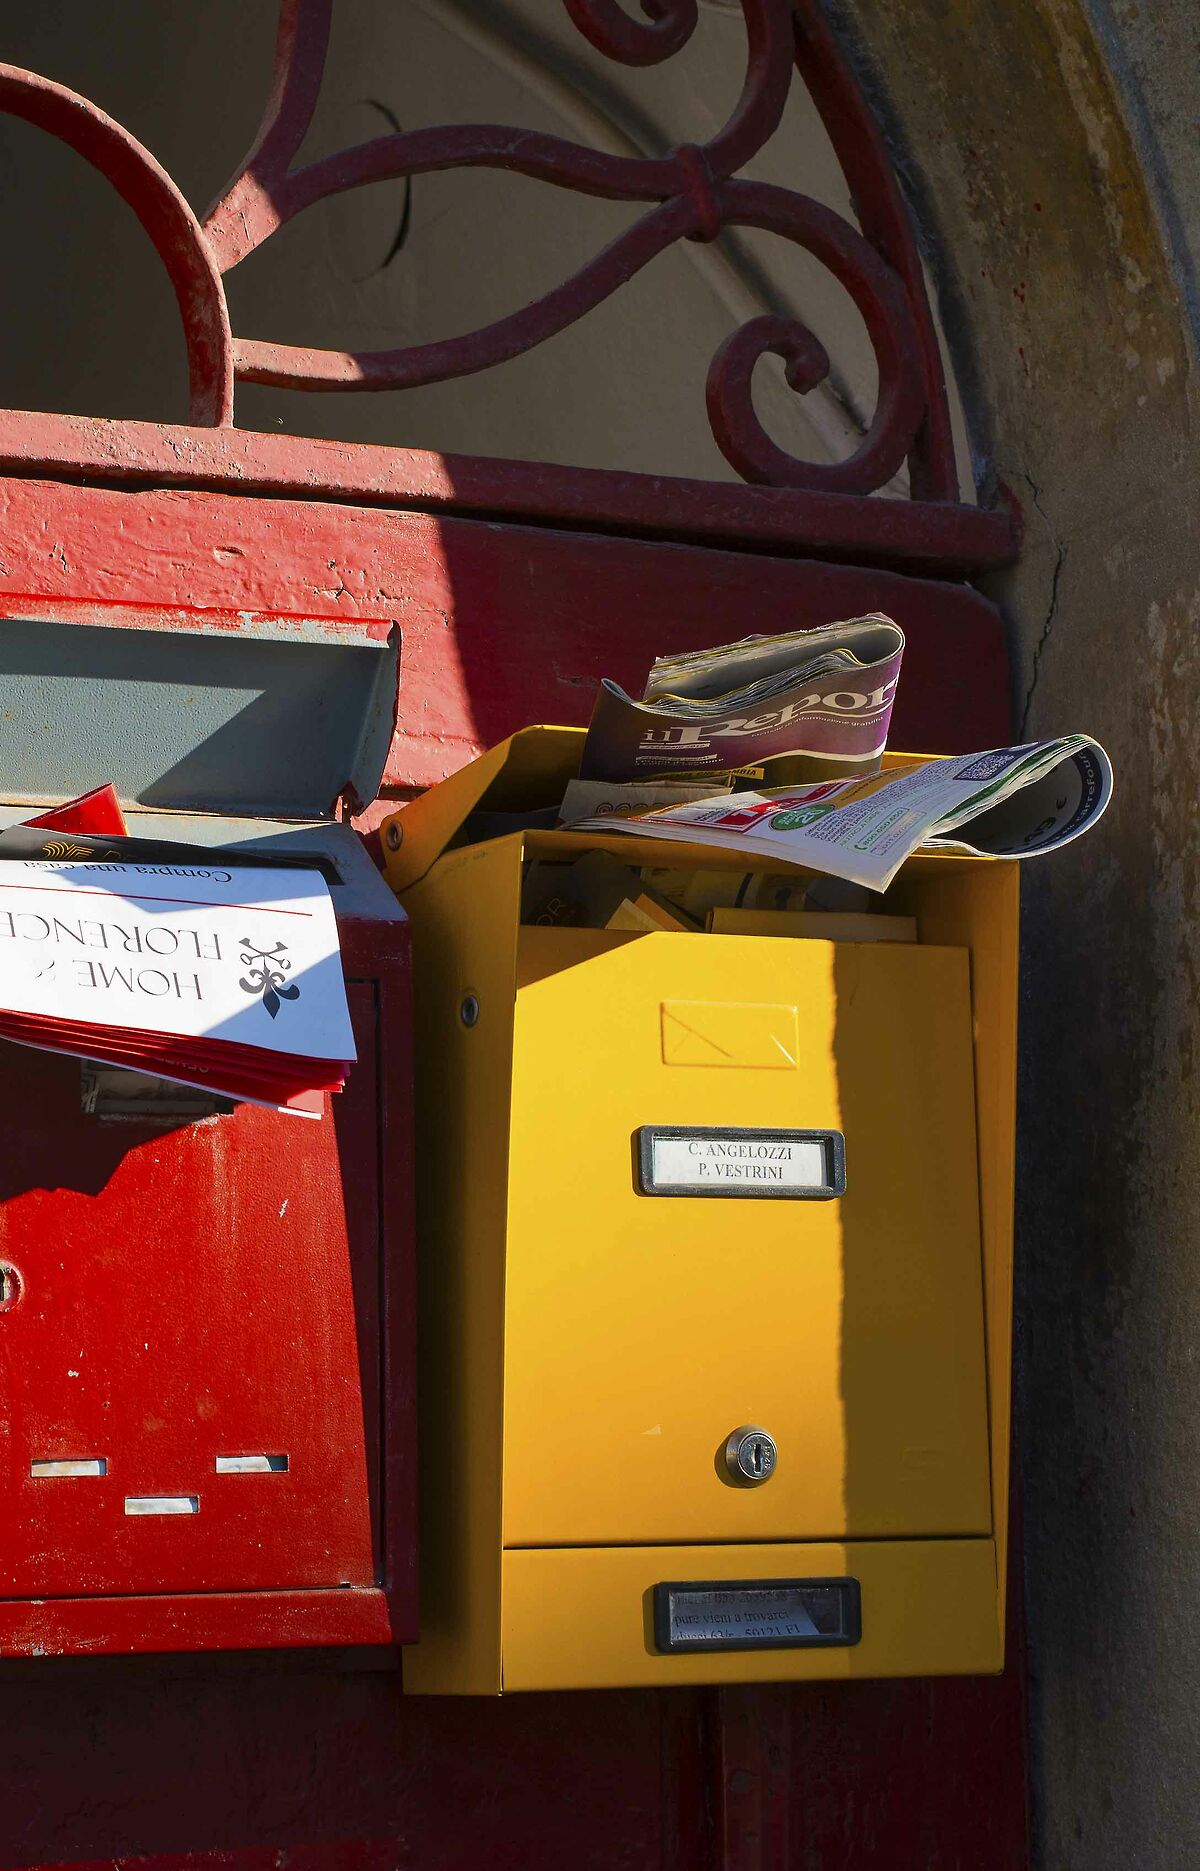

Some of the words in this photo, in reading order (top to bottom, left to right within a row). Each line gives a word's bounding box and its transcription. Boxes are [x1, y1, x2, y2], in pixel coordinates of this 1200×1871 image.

[83, 863, 129, 876] una
[133, 864, 233, 884] Compra
[71, 959, 202, 1000] HOME
[688, 1142, 702, 1156] C.
[706, 1144, 792, 1160] ANGELOZZI
[698, 1162, 710, 1176] P.
[715, 1164, 783, 1180] VESTRINI
